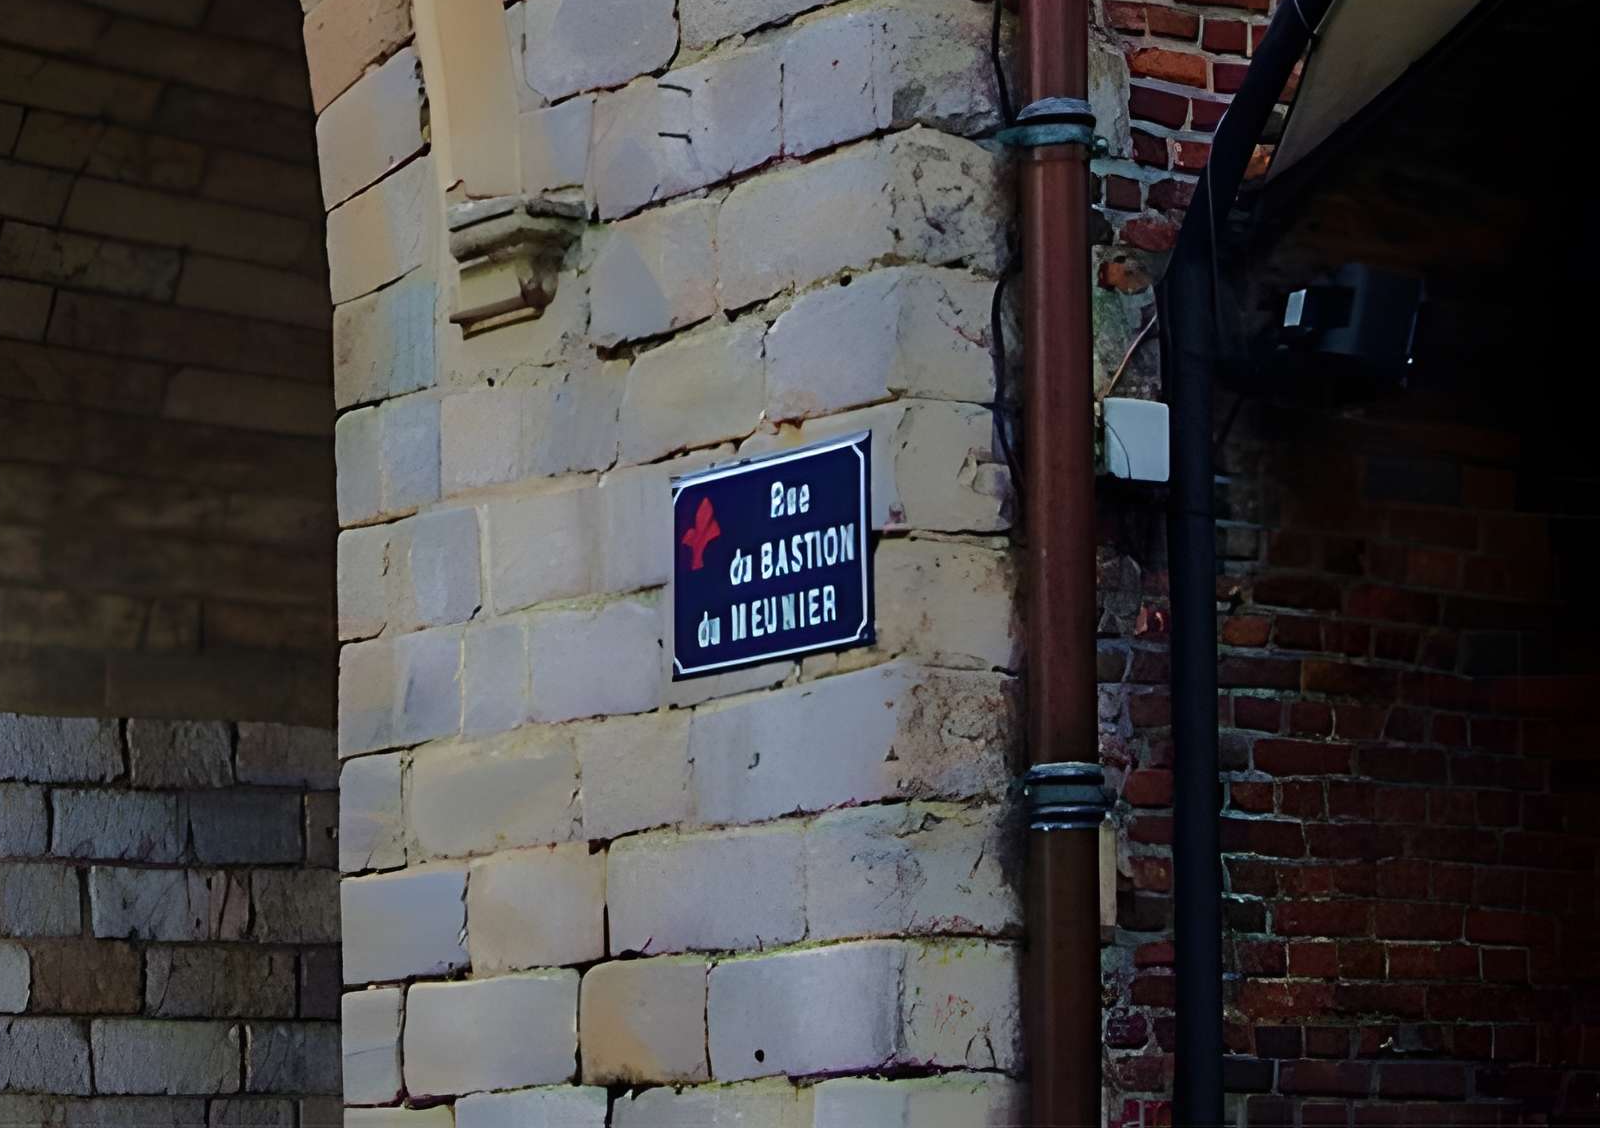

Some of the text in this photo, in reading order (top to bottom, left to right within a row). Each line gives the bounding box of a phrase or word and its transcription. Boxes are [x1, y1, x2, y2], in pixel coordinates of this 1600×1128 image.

[770, 481, 811, 518] Rue
[729, 523, 855, 585] du BASTION
[697, 584, 837, 648] du MEUNIER
